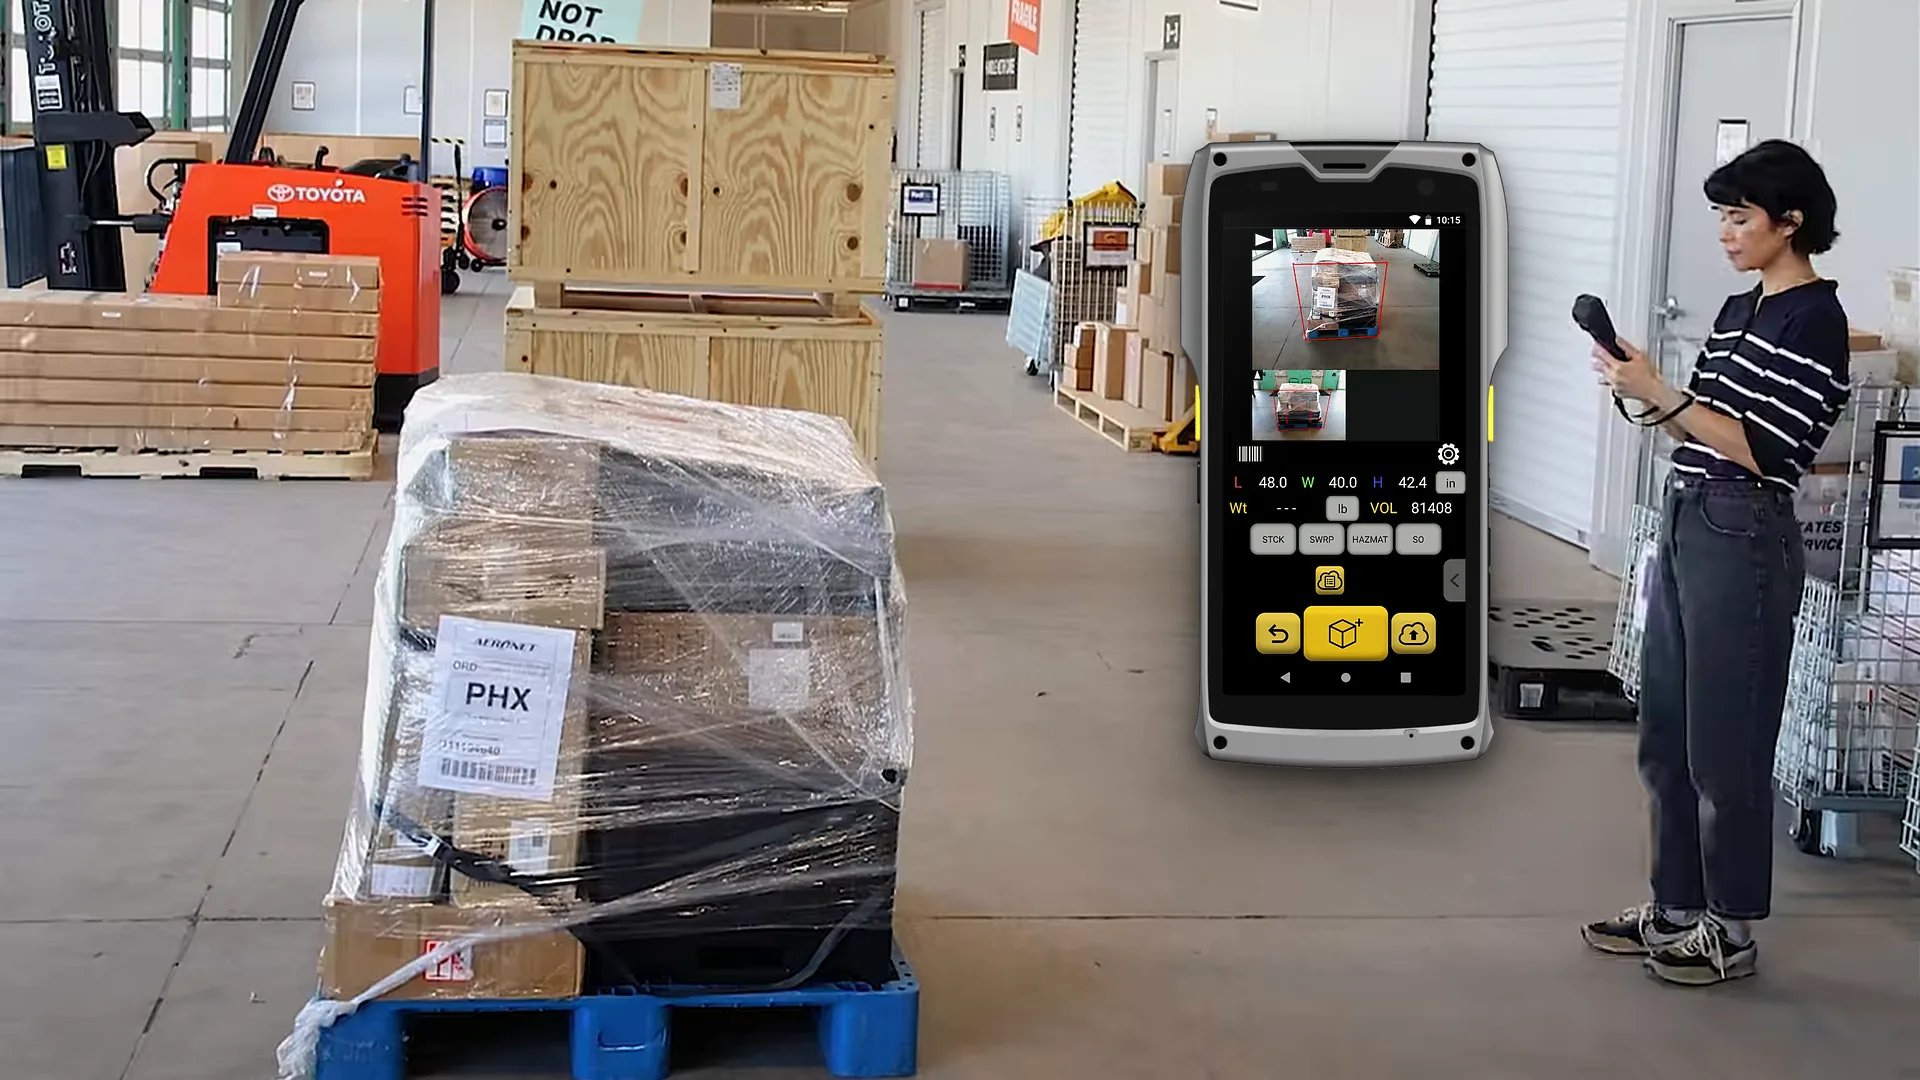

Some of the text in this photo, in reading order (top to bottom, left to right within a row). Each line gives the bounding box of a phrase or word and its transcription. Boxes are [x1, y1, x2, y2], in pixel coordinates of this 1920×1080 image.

[538, 0, 603, 28] NOT
[536, 24, 616, 44] DR
[295, 186, 366, 203] TOYOTA
[1436, 216, 1461, 225] 10:15
[1234, 476, 1456, 488] L 48.0 W 40.0 H 42.4 in
[1229, 502, 1248, 514] Wt
[1338, 503, 1348, 514] lb
[1370, 502, 1398, 514] VOL
[1411, 502, 1453, 514] 81408
[1262, 535, 1285, 544] STCK
[1309, 535, 1335, 544] SWRP
[1352, 535, 1389, 544] HAZMAT
[1412, 535, 1425, 544] SO
[452, 659, 478, 672] ORD
[465, 682, 531, 712] PHX
